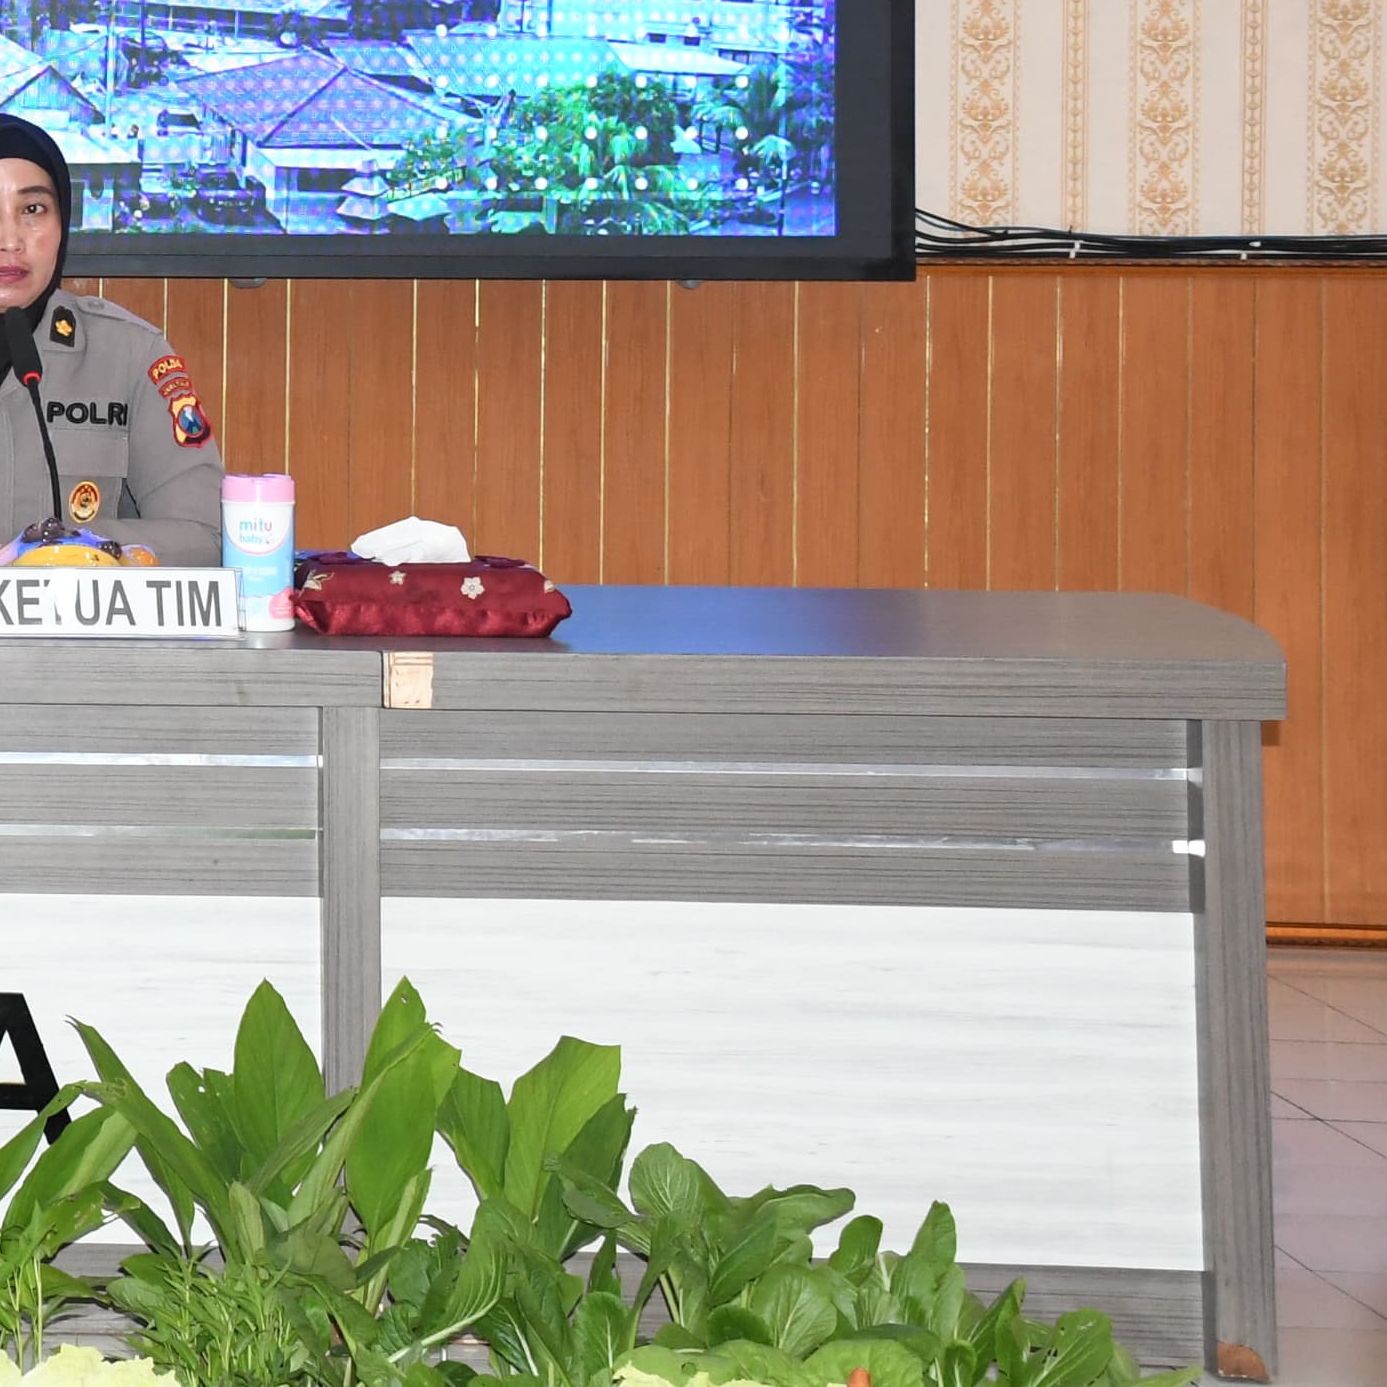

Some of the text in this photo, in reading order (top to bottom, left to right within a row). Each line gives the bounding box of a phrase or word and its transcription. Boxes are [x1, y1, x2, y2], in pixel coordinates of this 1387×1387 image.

[153, 358, 183, 380] POLDA
[46, 401, 128, 426] POLRI
[239, 518, 272, 532] mitu
[146, 580, 222, 627] TIM
